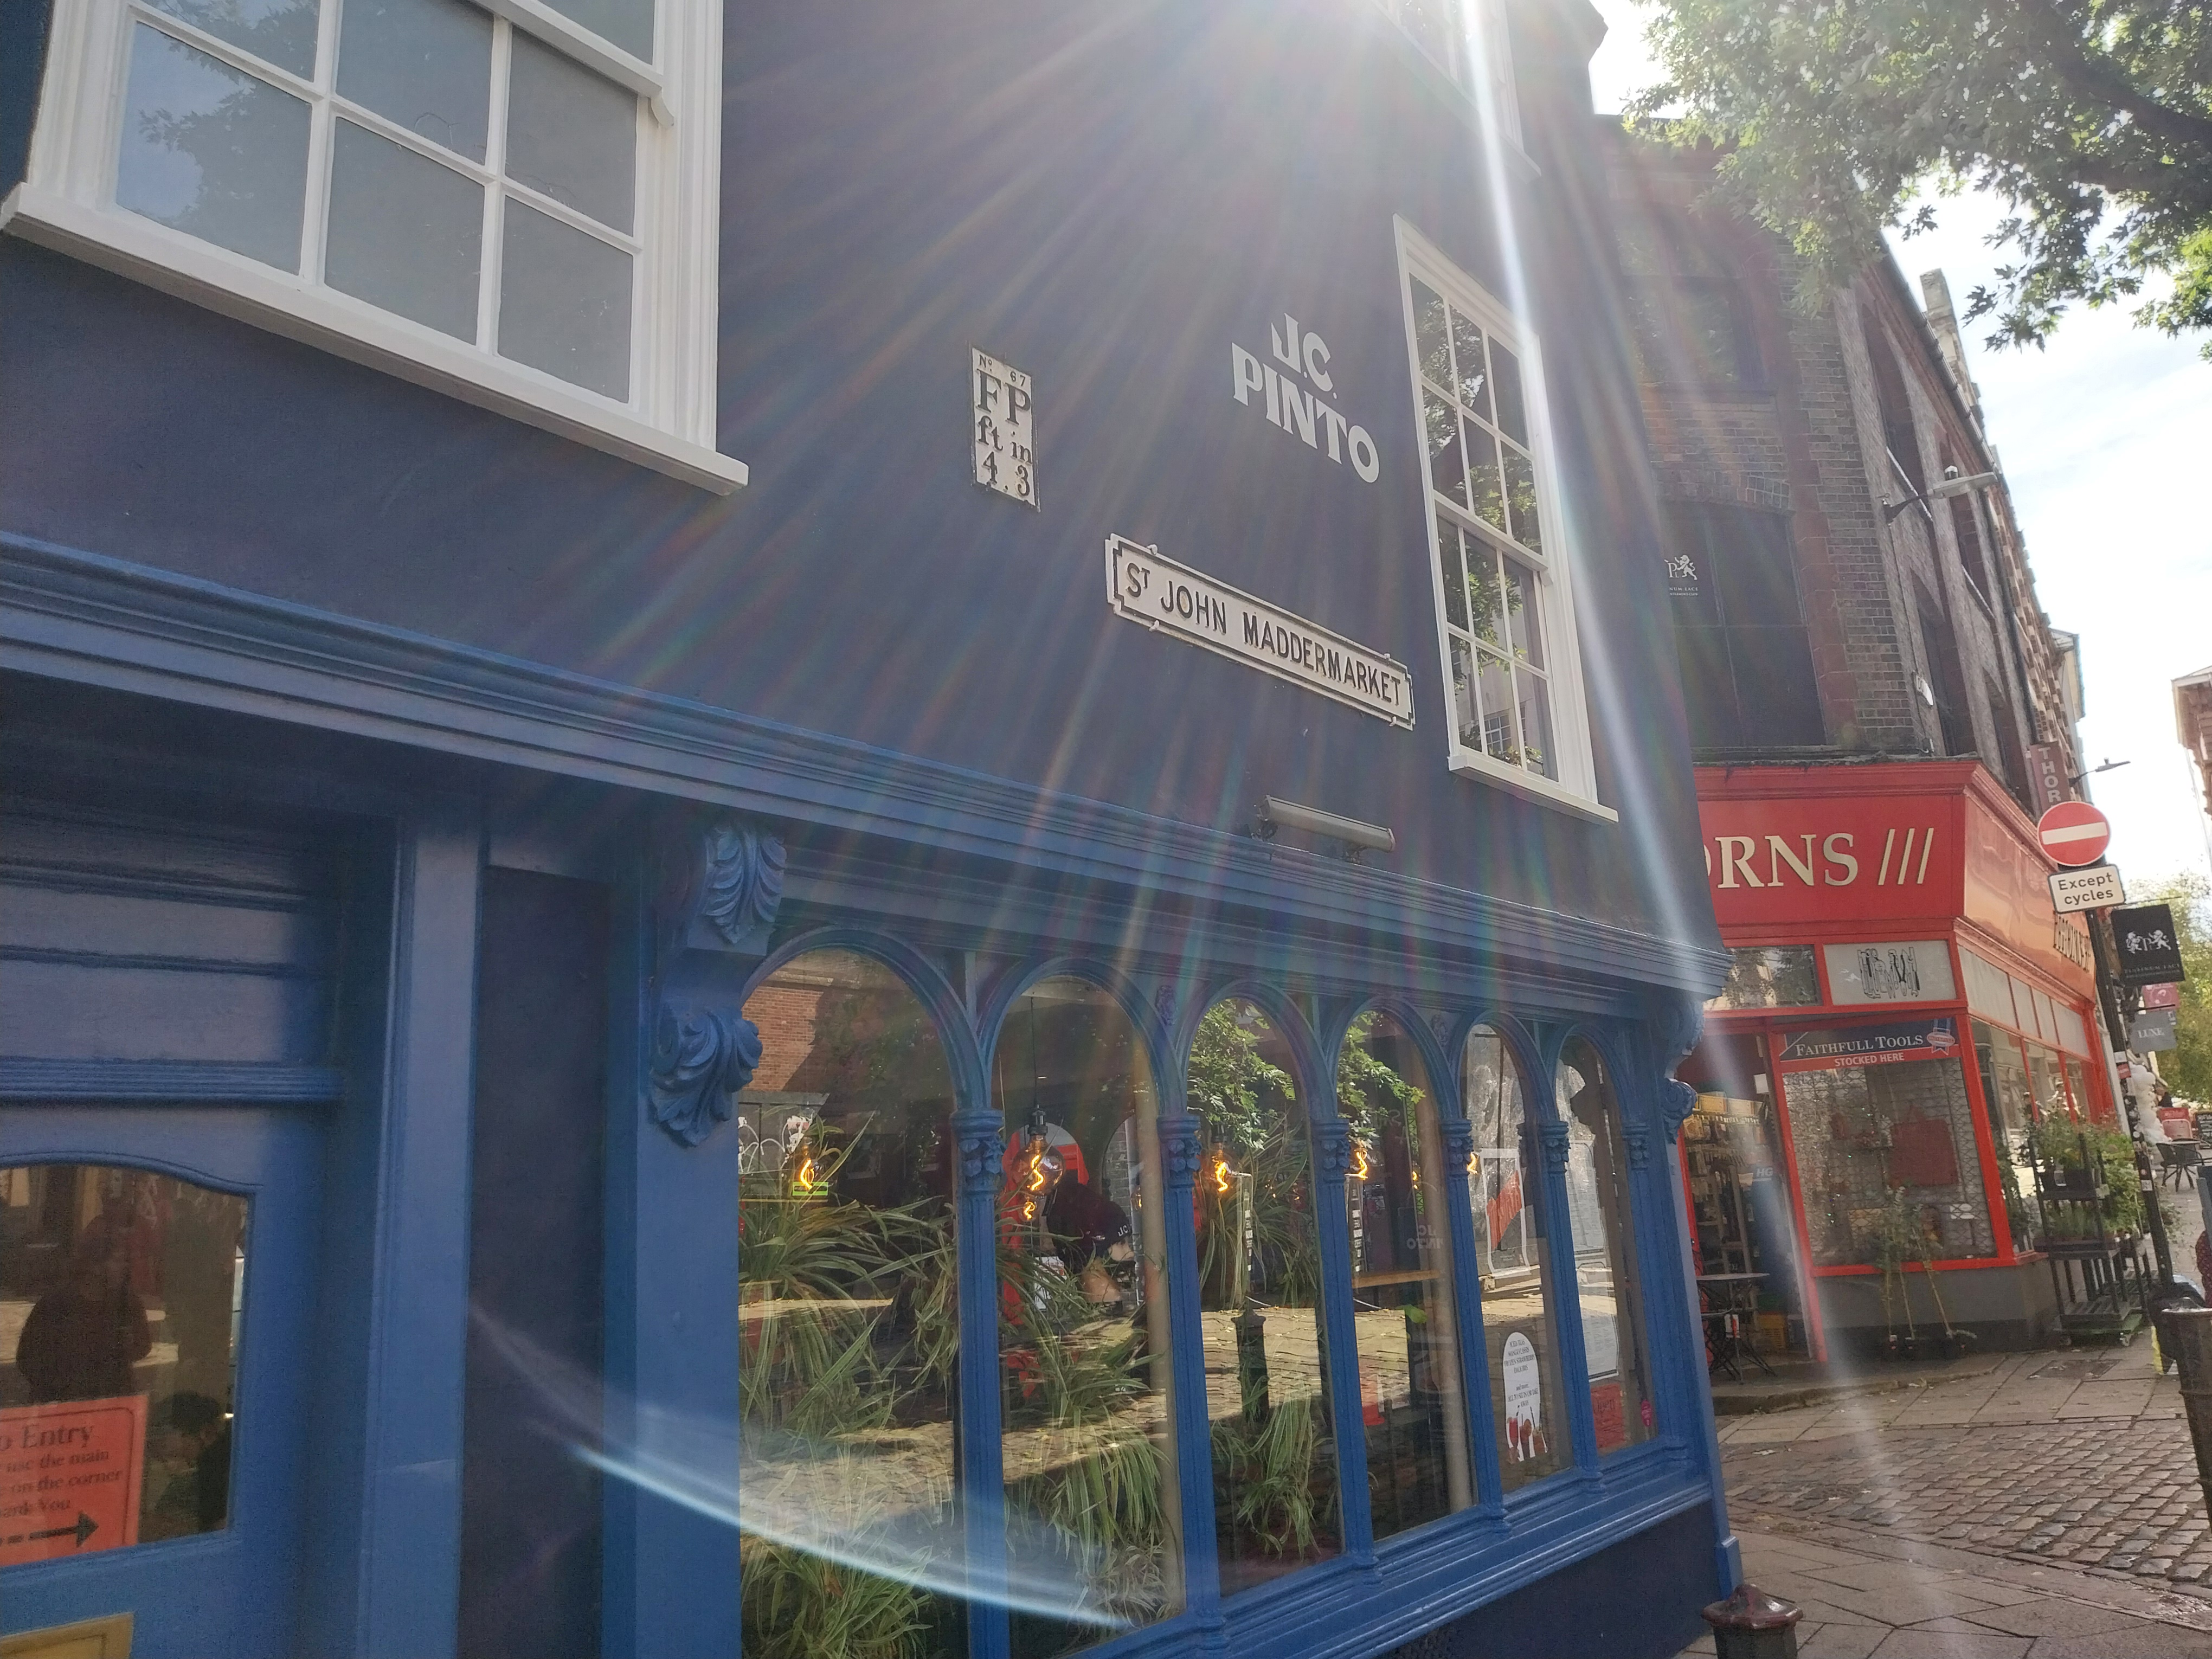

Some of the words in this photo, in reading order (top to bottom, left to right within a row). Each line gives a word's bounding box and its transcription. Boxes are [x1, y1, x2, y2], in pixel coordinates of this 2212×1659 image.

[1009, 371, 1026, 387] 87
[1232, 342, 1380, 483] PINTO
[1160, 580, 1227, 634] JOHN
[1242, 611, 1401, 707] MADDERMARKET
[2038, 747, 2063, 803] THOR
[2057, 872, 2114, 891] Except
[2064, 889, 2114, 906] cycles
[1796, 1042, 1874, 1057] FAITHFULL
[1875, 1034, 1924, 1049] TOOLS
[1834, 1055, 1877, 1068] STOCKED
[1880, 1052, 1905, 1064] HERE
[23, 1425, 94, 1448] Entry
[40, 1451, 65, 1468] the
[69, 1449, 109, 1465] main
[37, 1475, 64, 1492] the
[68, 1469, 123, 1486] corner
